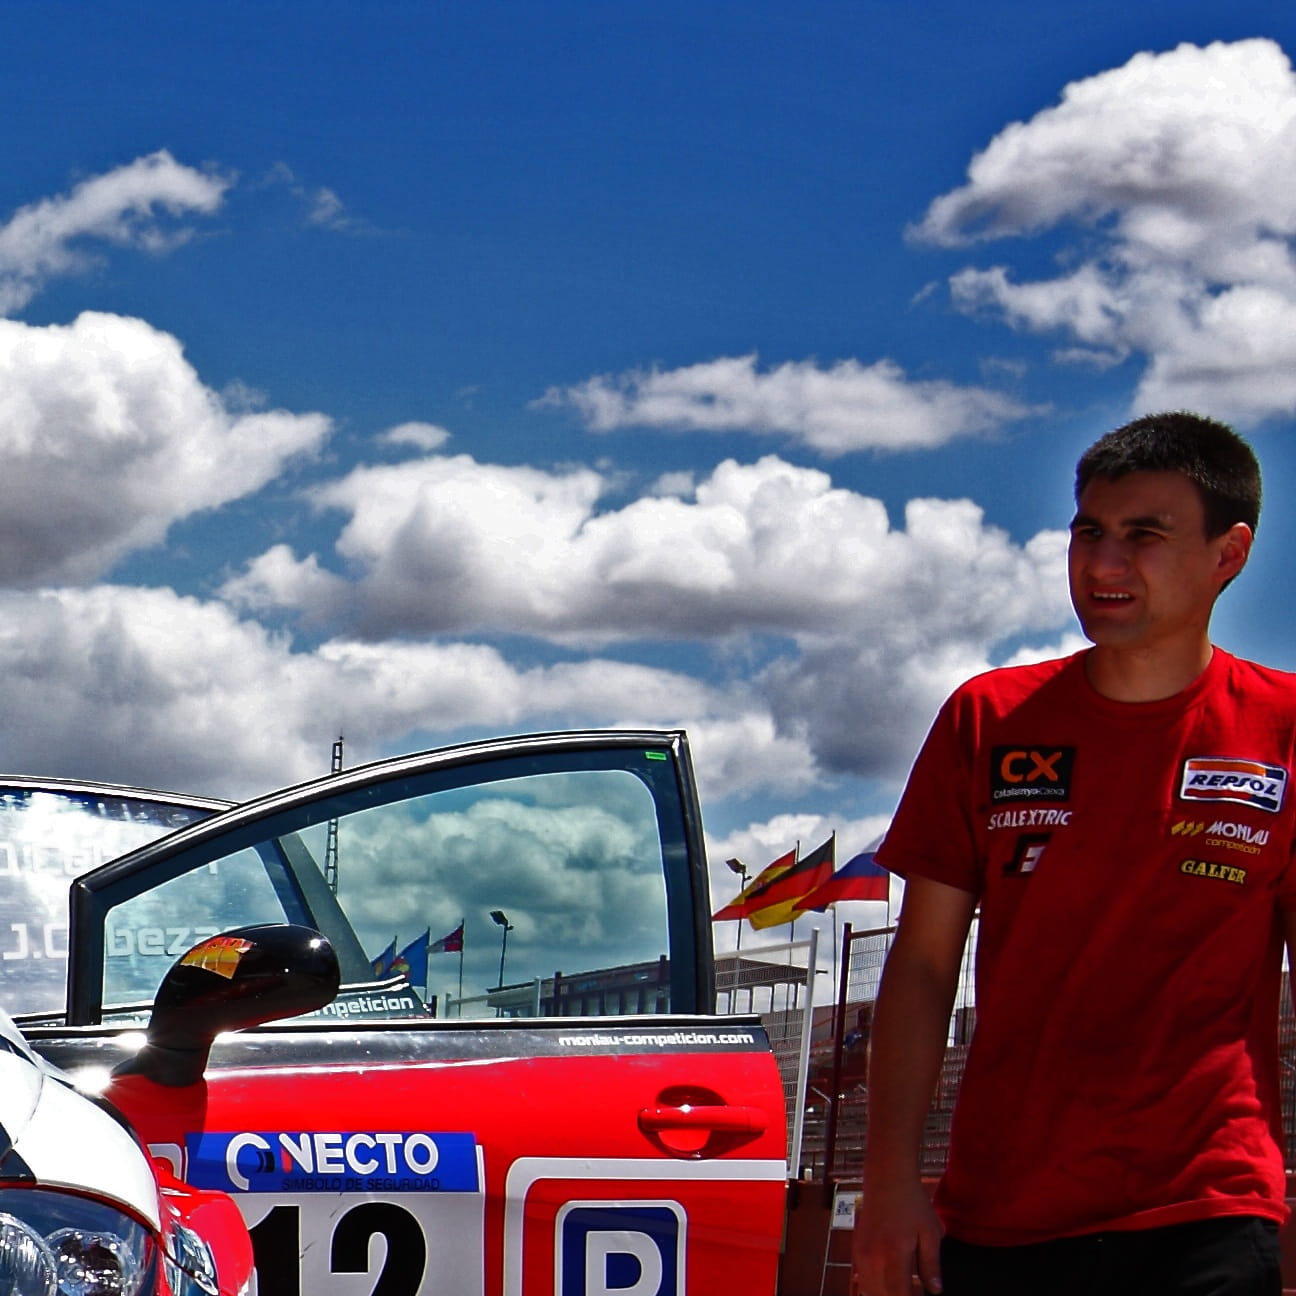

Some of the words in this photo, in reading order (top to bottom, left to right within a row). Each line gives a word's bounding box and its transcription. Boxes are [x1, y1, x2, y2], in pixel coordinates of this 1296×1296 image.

[1000, 751, 1063, 783] CX
[1188, 774, 1278, 796] REPSOL
[987, 808, 1073, 830] SCALEXTRIC
[1205, 820, 1270, 846] MONLAU
[1181, 860, 1247, 884] GALFER
[346, 1177, 364, 1191] DE
